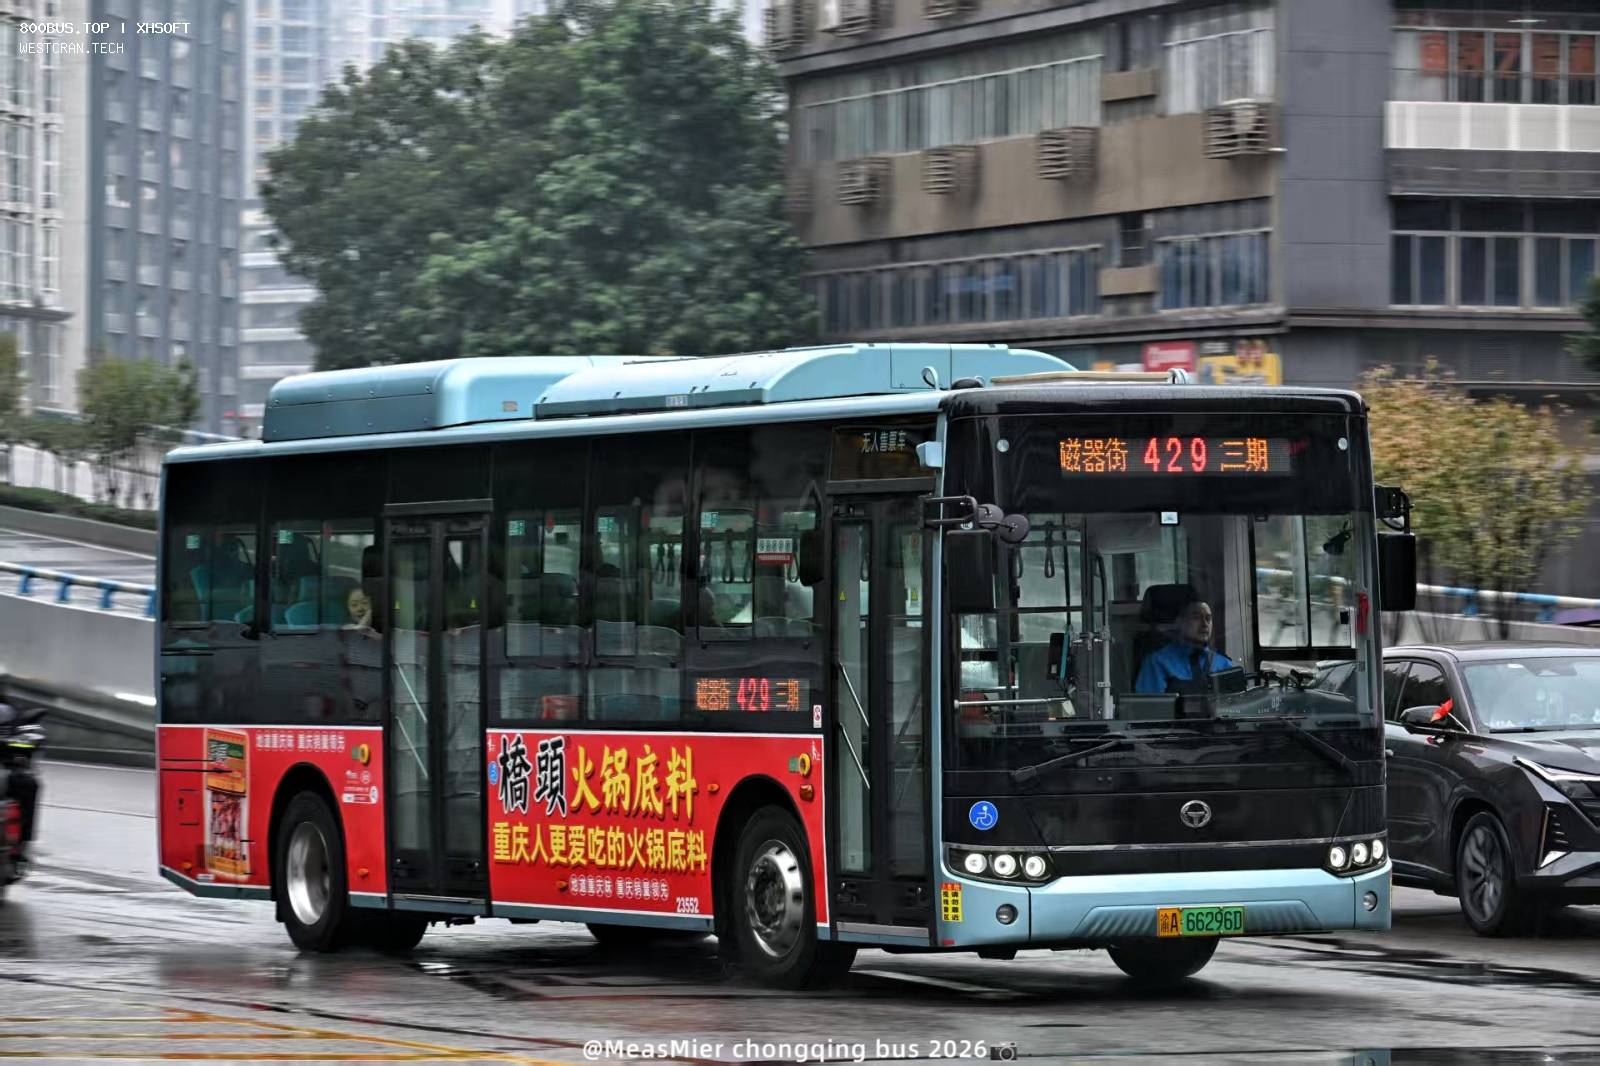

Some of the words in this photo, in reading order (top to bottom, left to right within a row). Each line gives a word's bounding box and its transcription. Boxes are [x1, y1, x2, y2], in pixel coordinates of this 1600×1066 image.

[1144, 437, 1208, 472] 429
[1220, 438, 1268, 472] 三期
[736, 678, 769, 711] 429
[570, 744, 698, 820] 火锅底料
[492, 821, 707, 872] 重庆人更爱吃的火锅底料
[676, 896, 699, 914] 23552
